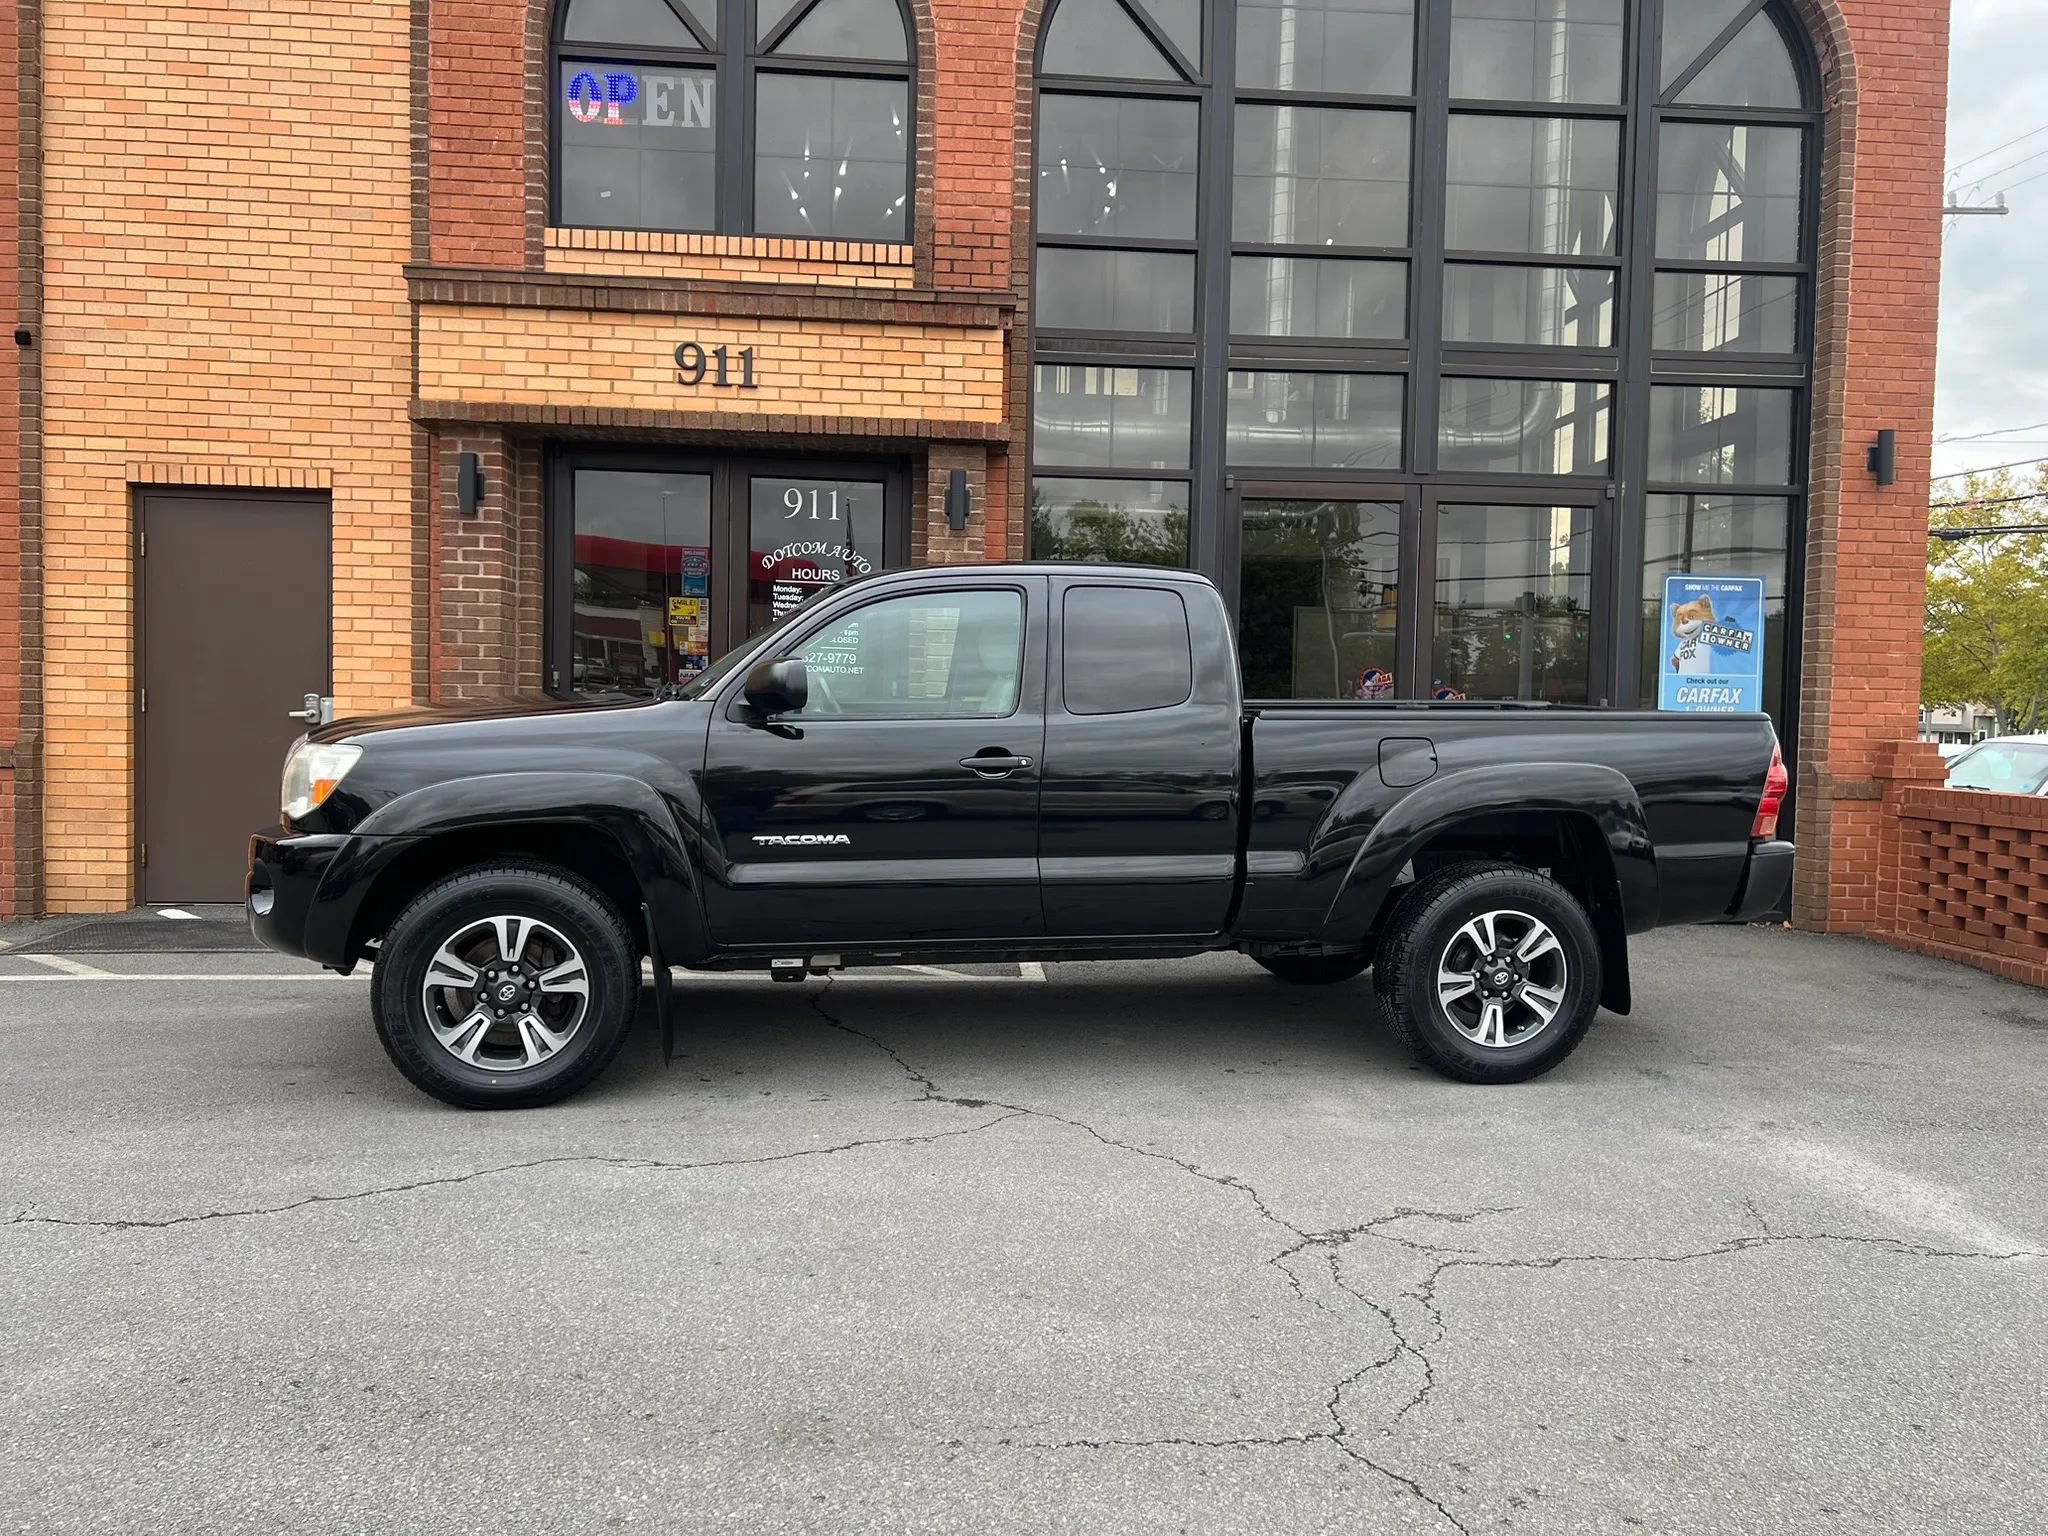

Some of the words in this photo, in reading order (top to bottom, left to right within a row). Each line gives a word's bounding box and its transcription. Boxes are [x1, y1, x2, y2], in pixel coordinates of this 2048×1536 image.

[567, 70, 714, 128] OPEN
[674, 341, 758, 389] 911
[783, 487, 841, 521] 911
[791, 568, 840, 580] HOURS
[773, 585, 802, 593] Monday:
[773, 593, 804, 601] Tuesday:
[1704, 624, 1752, 641] CARFAX
[829, 636, 859, 644] LOSED
[1680, 648, 1697, 660] FOX
[1676, 687, 1743, 704] CARFAX
[751, 834, 851, 846] TACOMA
